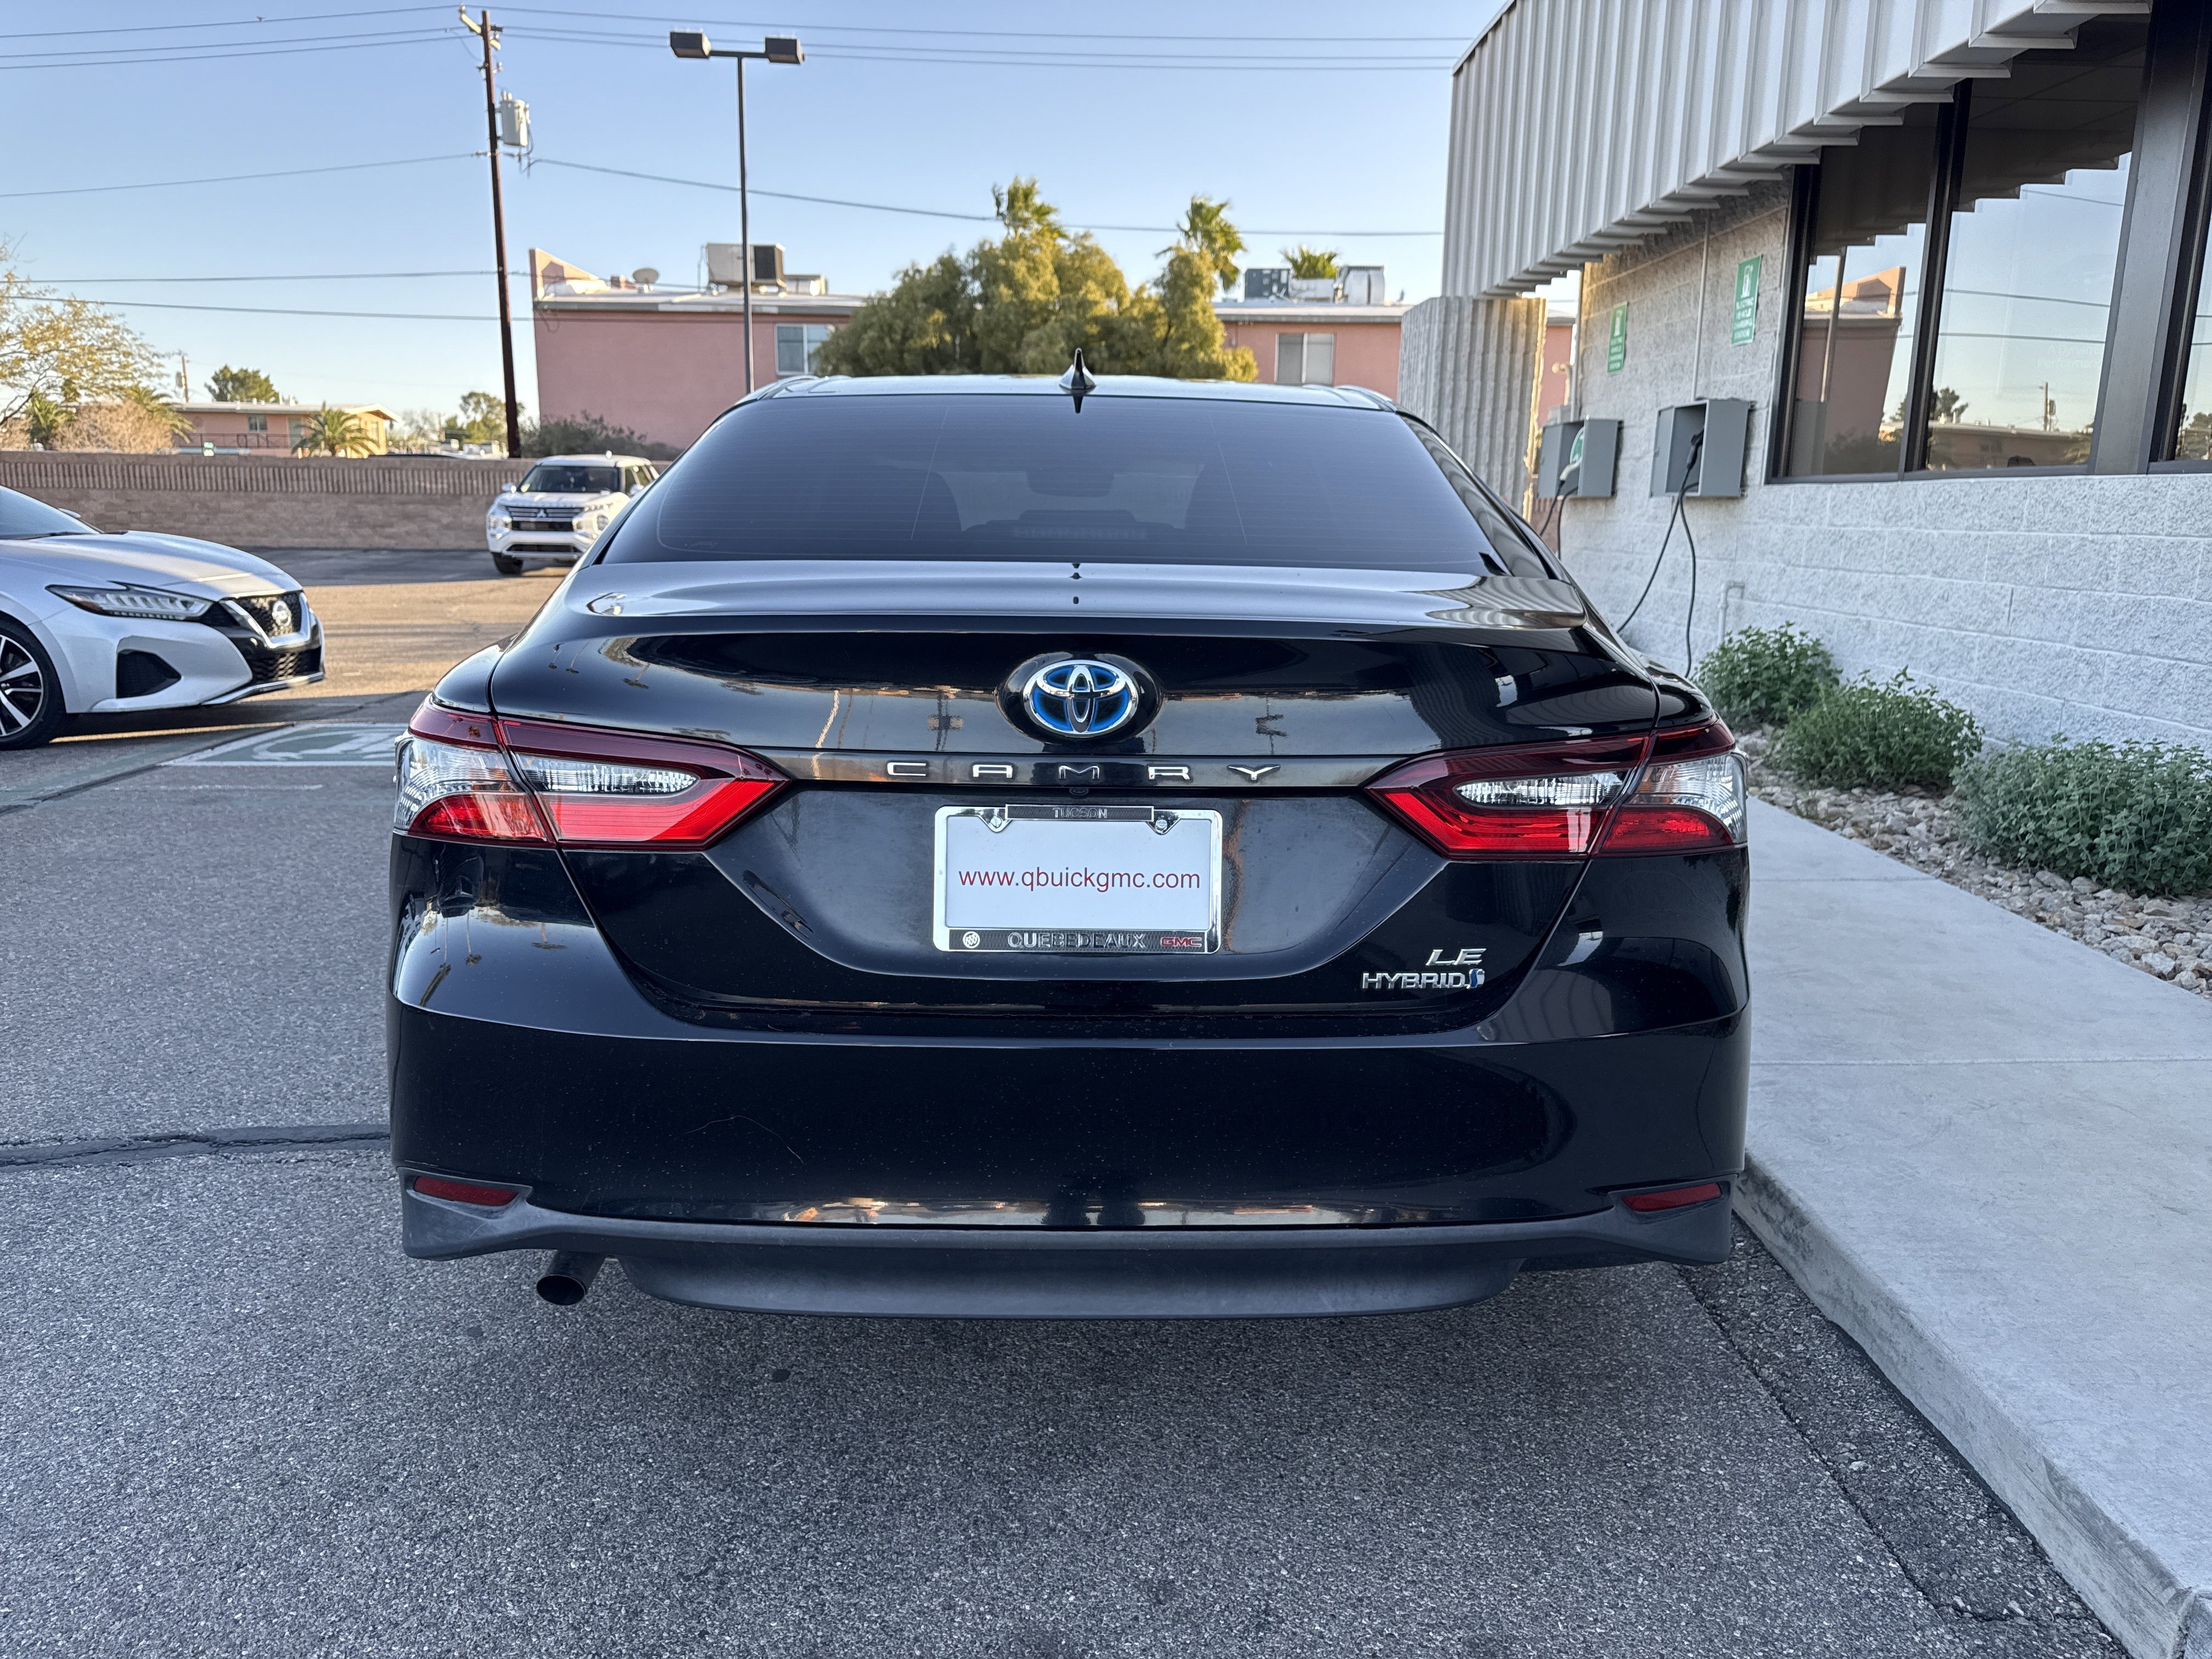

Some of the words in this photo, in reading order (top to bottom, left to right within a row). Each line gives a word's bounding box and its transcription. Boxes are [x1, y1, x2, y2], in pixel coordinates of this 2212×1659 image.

[887, 761, 1282, 781] CAMRY
[1052, 808, 1108, 819] TUCSON
[958, 867, 1201, 893] www.qbuickgmc.com
[1007, 932, 1147, 949] QUEBEDEAUX
[1160, 936, 1203, 947] GMC
[1425, 948, 1487, 966] LE
[1362, 973, 1466, 989] HYBRID
